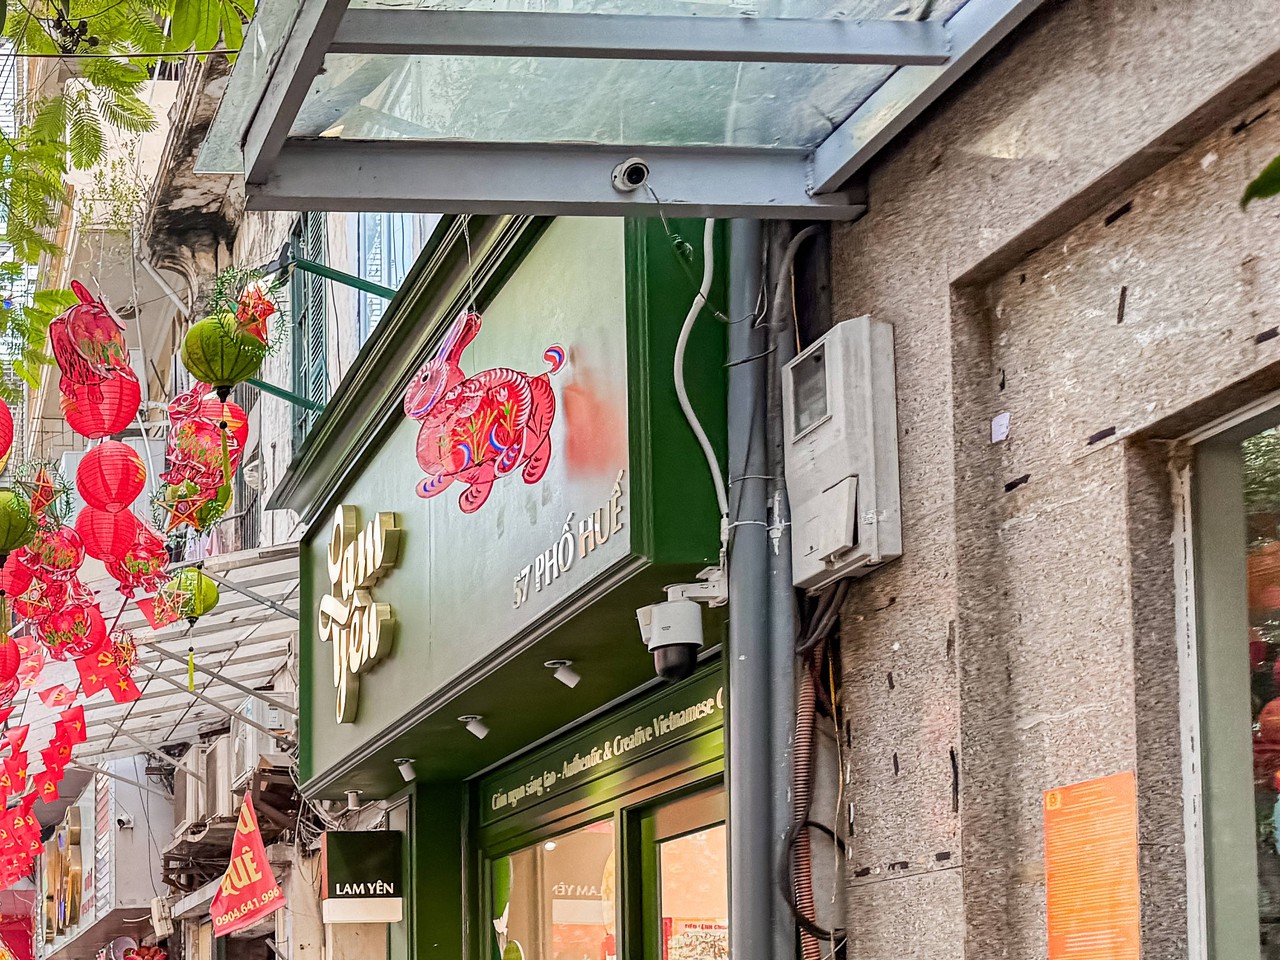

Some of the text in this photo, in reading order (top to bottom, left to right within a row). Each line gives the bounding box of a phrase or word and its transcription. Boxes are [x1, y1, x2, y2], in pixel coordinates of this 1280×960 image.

[513, 469, 625, 609] 57 PHỐ HUẾ
[562, 746, 603, 779] Authentic
[603, 741, 613, 760] &
[613, 725, 653, 756] Creative
[653, 697, 715, 737] Vietnamese
[215, 886, 280, 926] 0904.641.996
[336, 880, 394, 895] LAM YÊN
